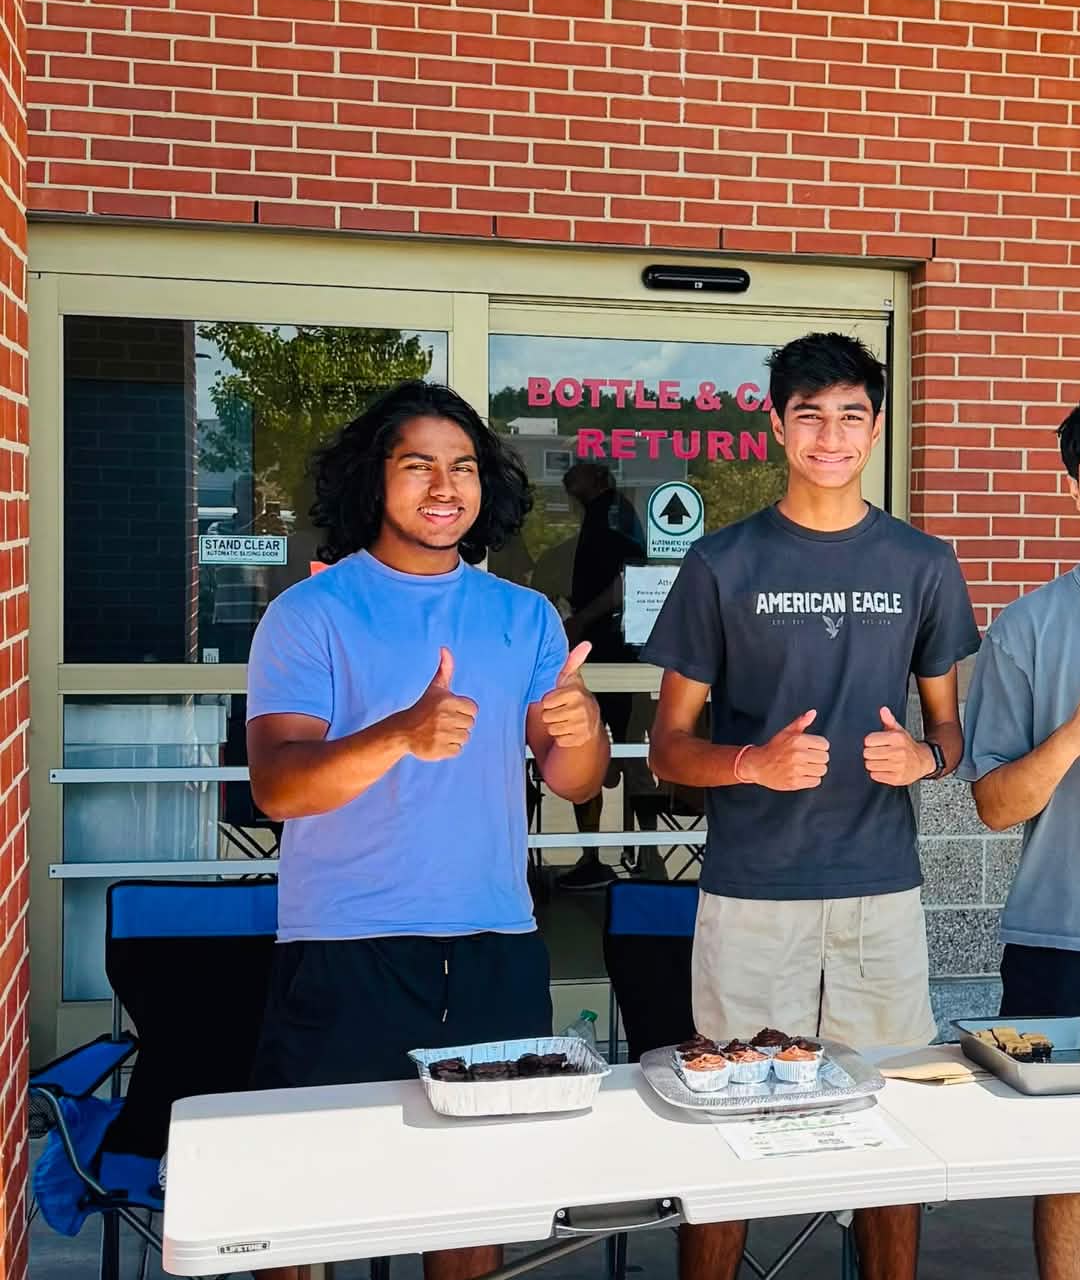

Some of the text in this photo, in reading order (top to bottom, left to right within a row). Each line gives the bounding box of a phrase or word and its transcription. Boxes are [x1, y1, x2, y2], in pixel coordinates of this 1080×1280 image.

[527, 376, 681, 410] BOTTLE
[695, 380, 723, 412] &
[577, 428, 768, 462] RETURN
[205, 539, 280, 551] STAND CLEAR
[756, 591, 903, 614] AMERICAN EAGLE
